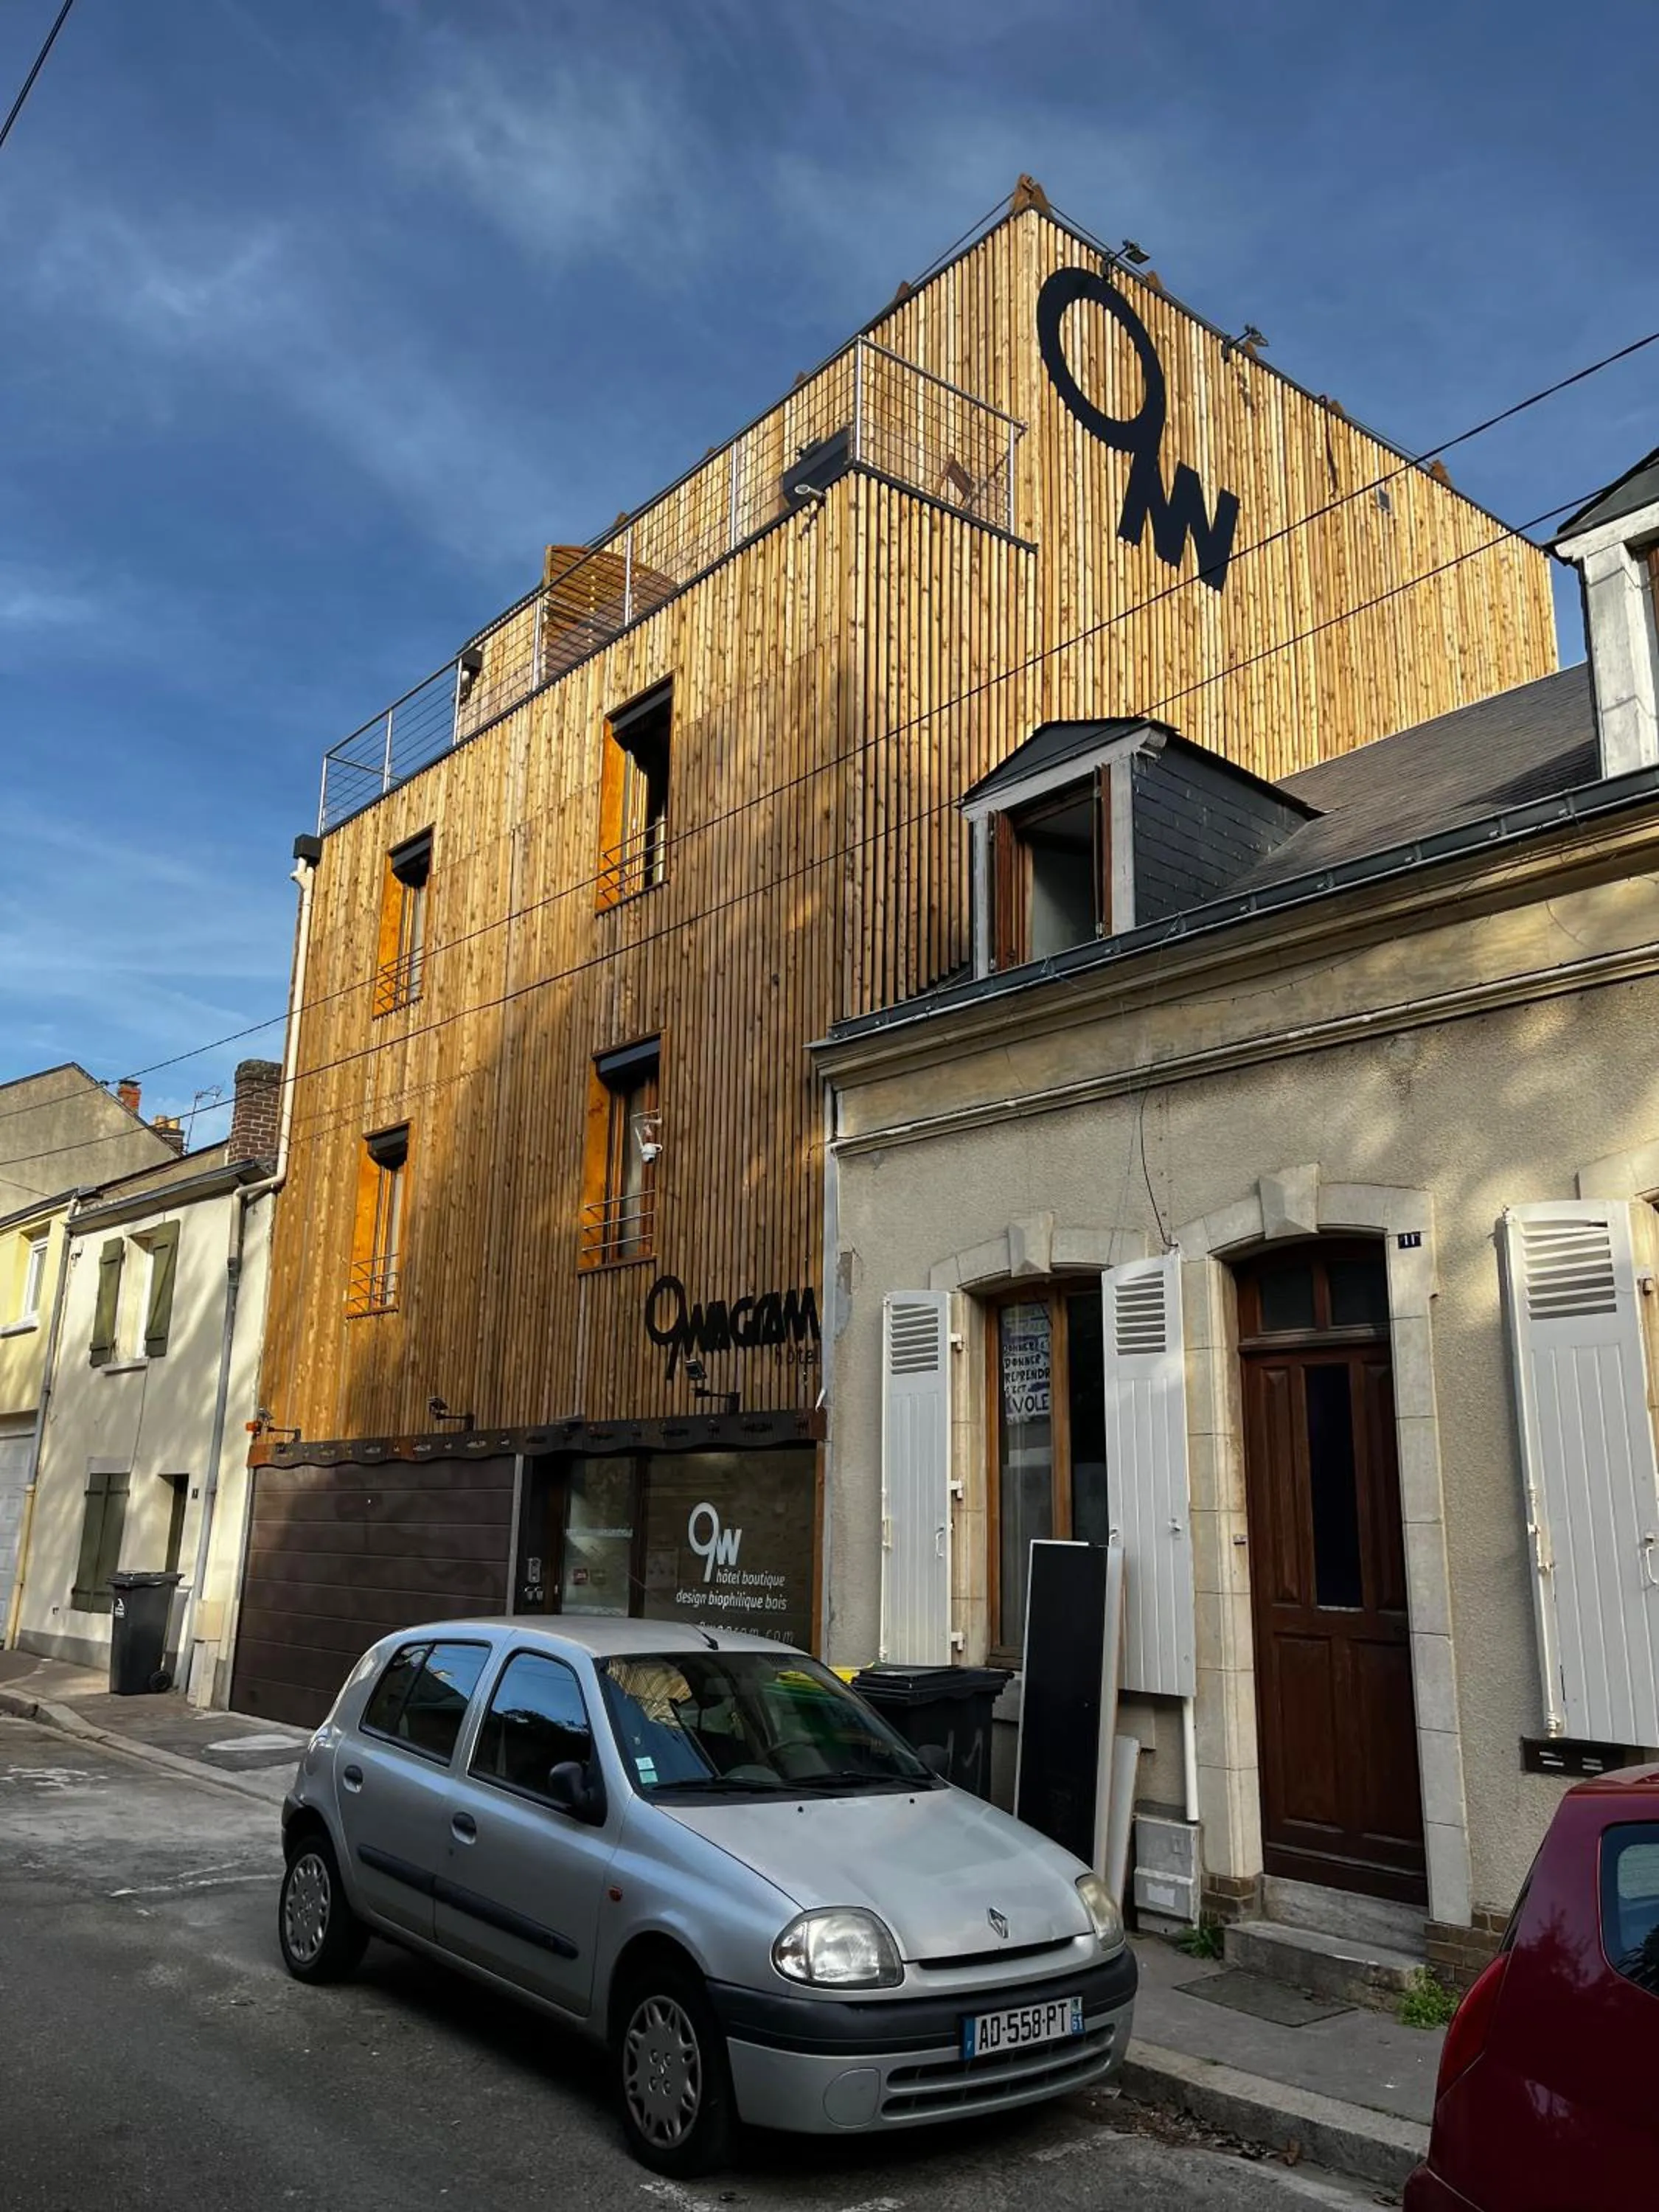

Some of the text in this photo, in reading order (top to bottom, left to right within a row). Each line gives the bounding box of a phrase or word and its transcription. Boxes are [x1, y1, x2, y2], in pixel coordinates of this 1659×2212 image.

[716, 1568, 785, 1589] hôtel boutique
[675, 1588, 787, 1611] design biophilique bois
